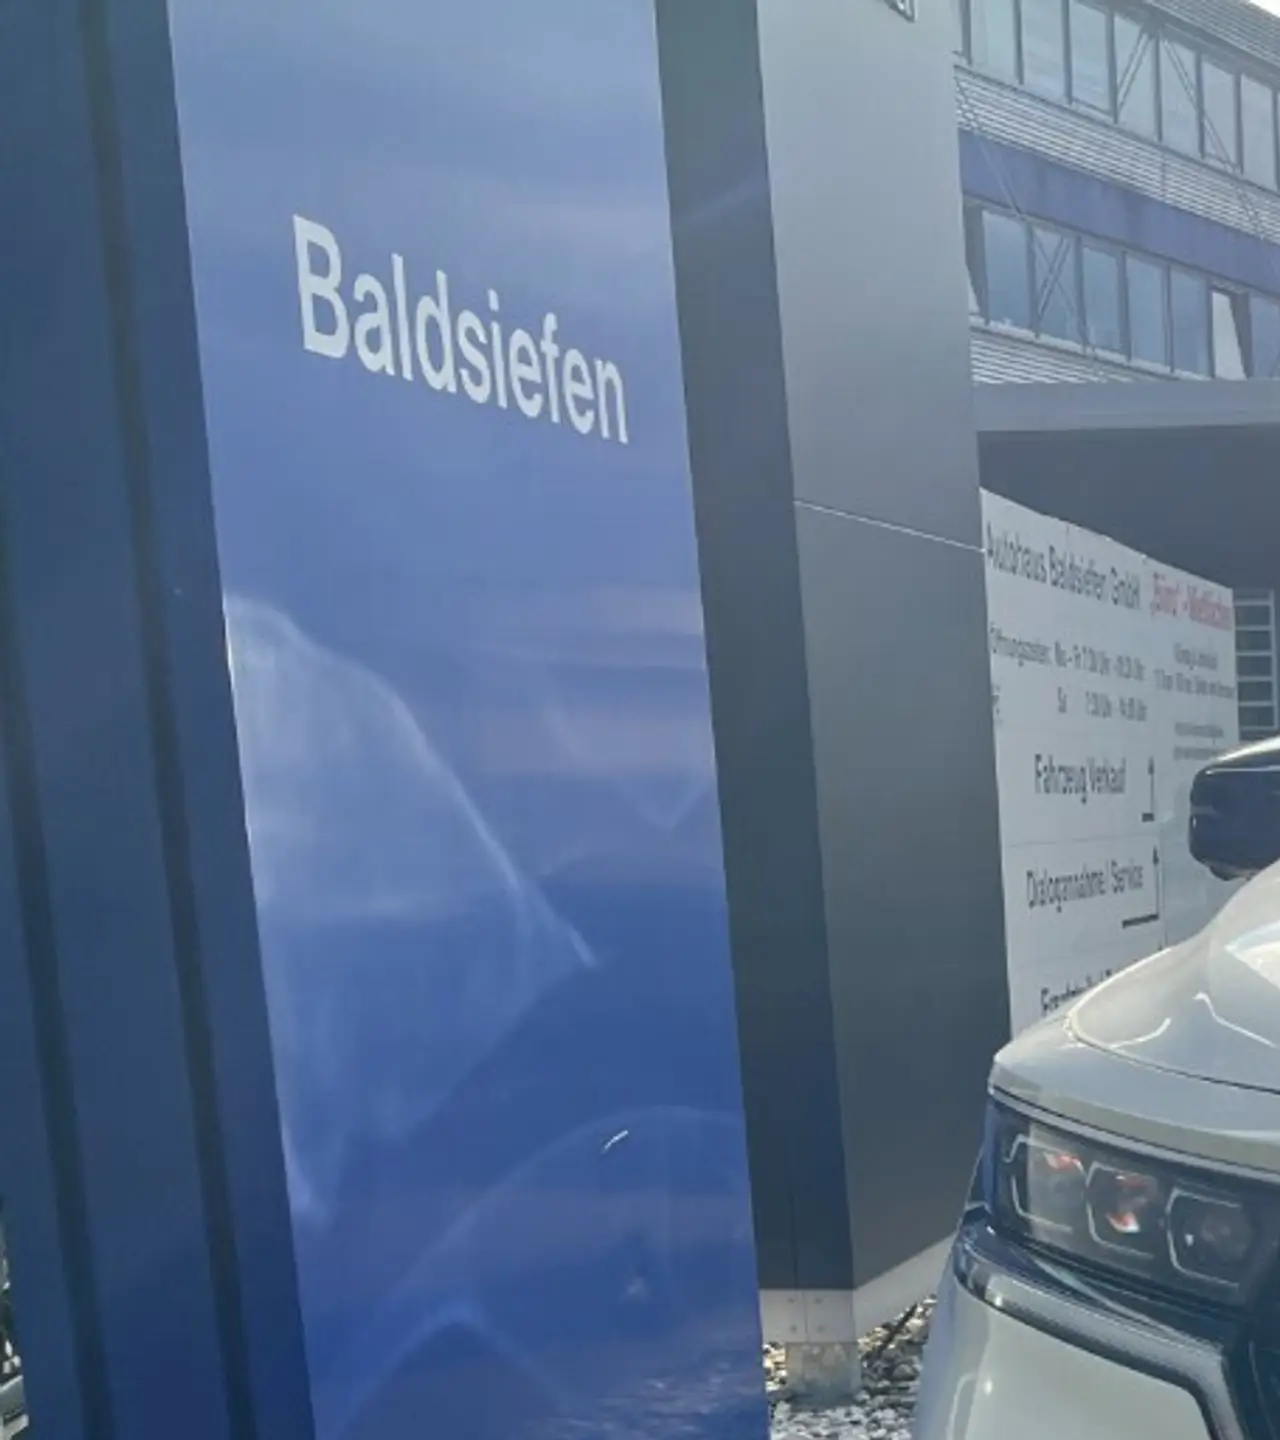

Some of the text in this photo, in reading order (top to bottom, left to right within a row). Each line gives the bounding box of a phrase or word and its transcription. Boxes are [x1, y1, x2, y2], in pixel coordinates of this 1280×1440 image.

[293, 214, 629, 444] Baldsiefen
[986, 520, 1047, 585] Autohaus
[1049, 544, 1107, 602] Baldsiefen
[1034, 752, 1126, 806] Fahrzeug Verkauf
[1110, 858, 1144, 895] Service
